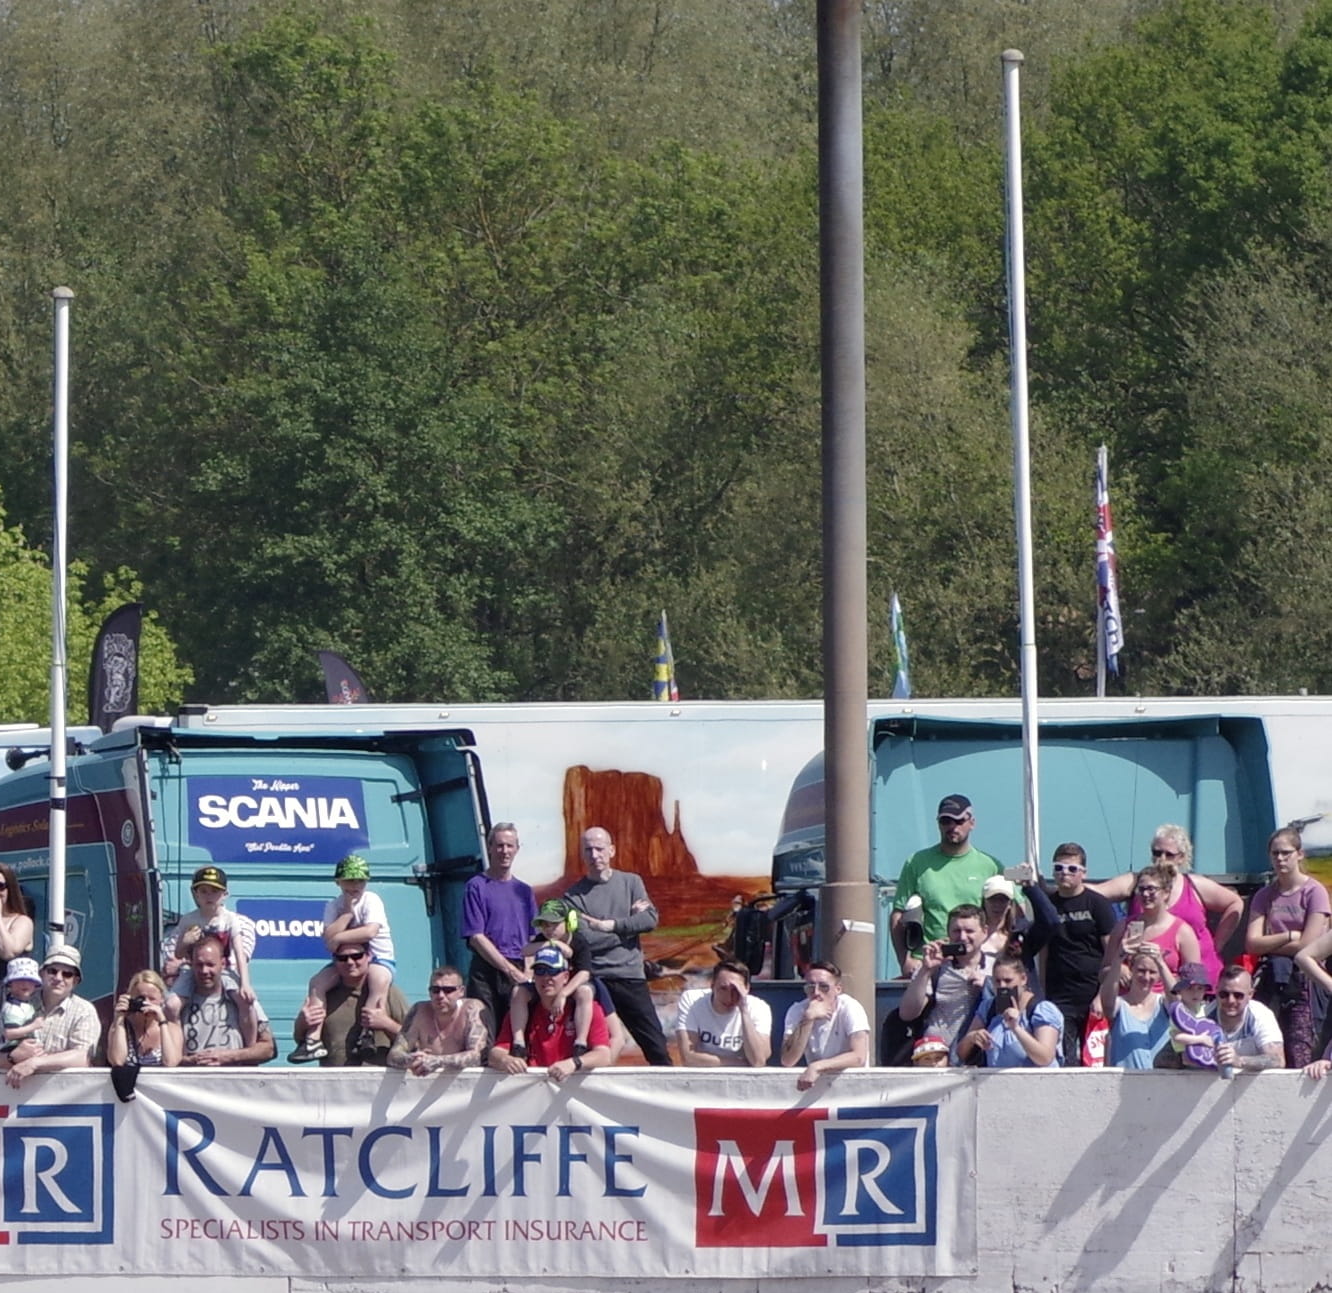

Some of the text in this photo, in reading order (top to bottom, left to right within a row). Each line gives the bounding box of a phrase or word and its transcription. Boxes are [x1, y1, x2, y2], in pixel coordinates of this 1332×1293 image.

[198, 795, 360, 829] SCANIA
[255, 920, 324, 937] OLLOCK
[163, 1109, 648, 1200] RATCLIFFE
[161, 1218, 648, 1243] SPECIALISTS IN TRANSPORT INSURANCE
